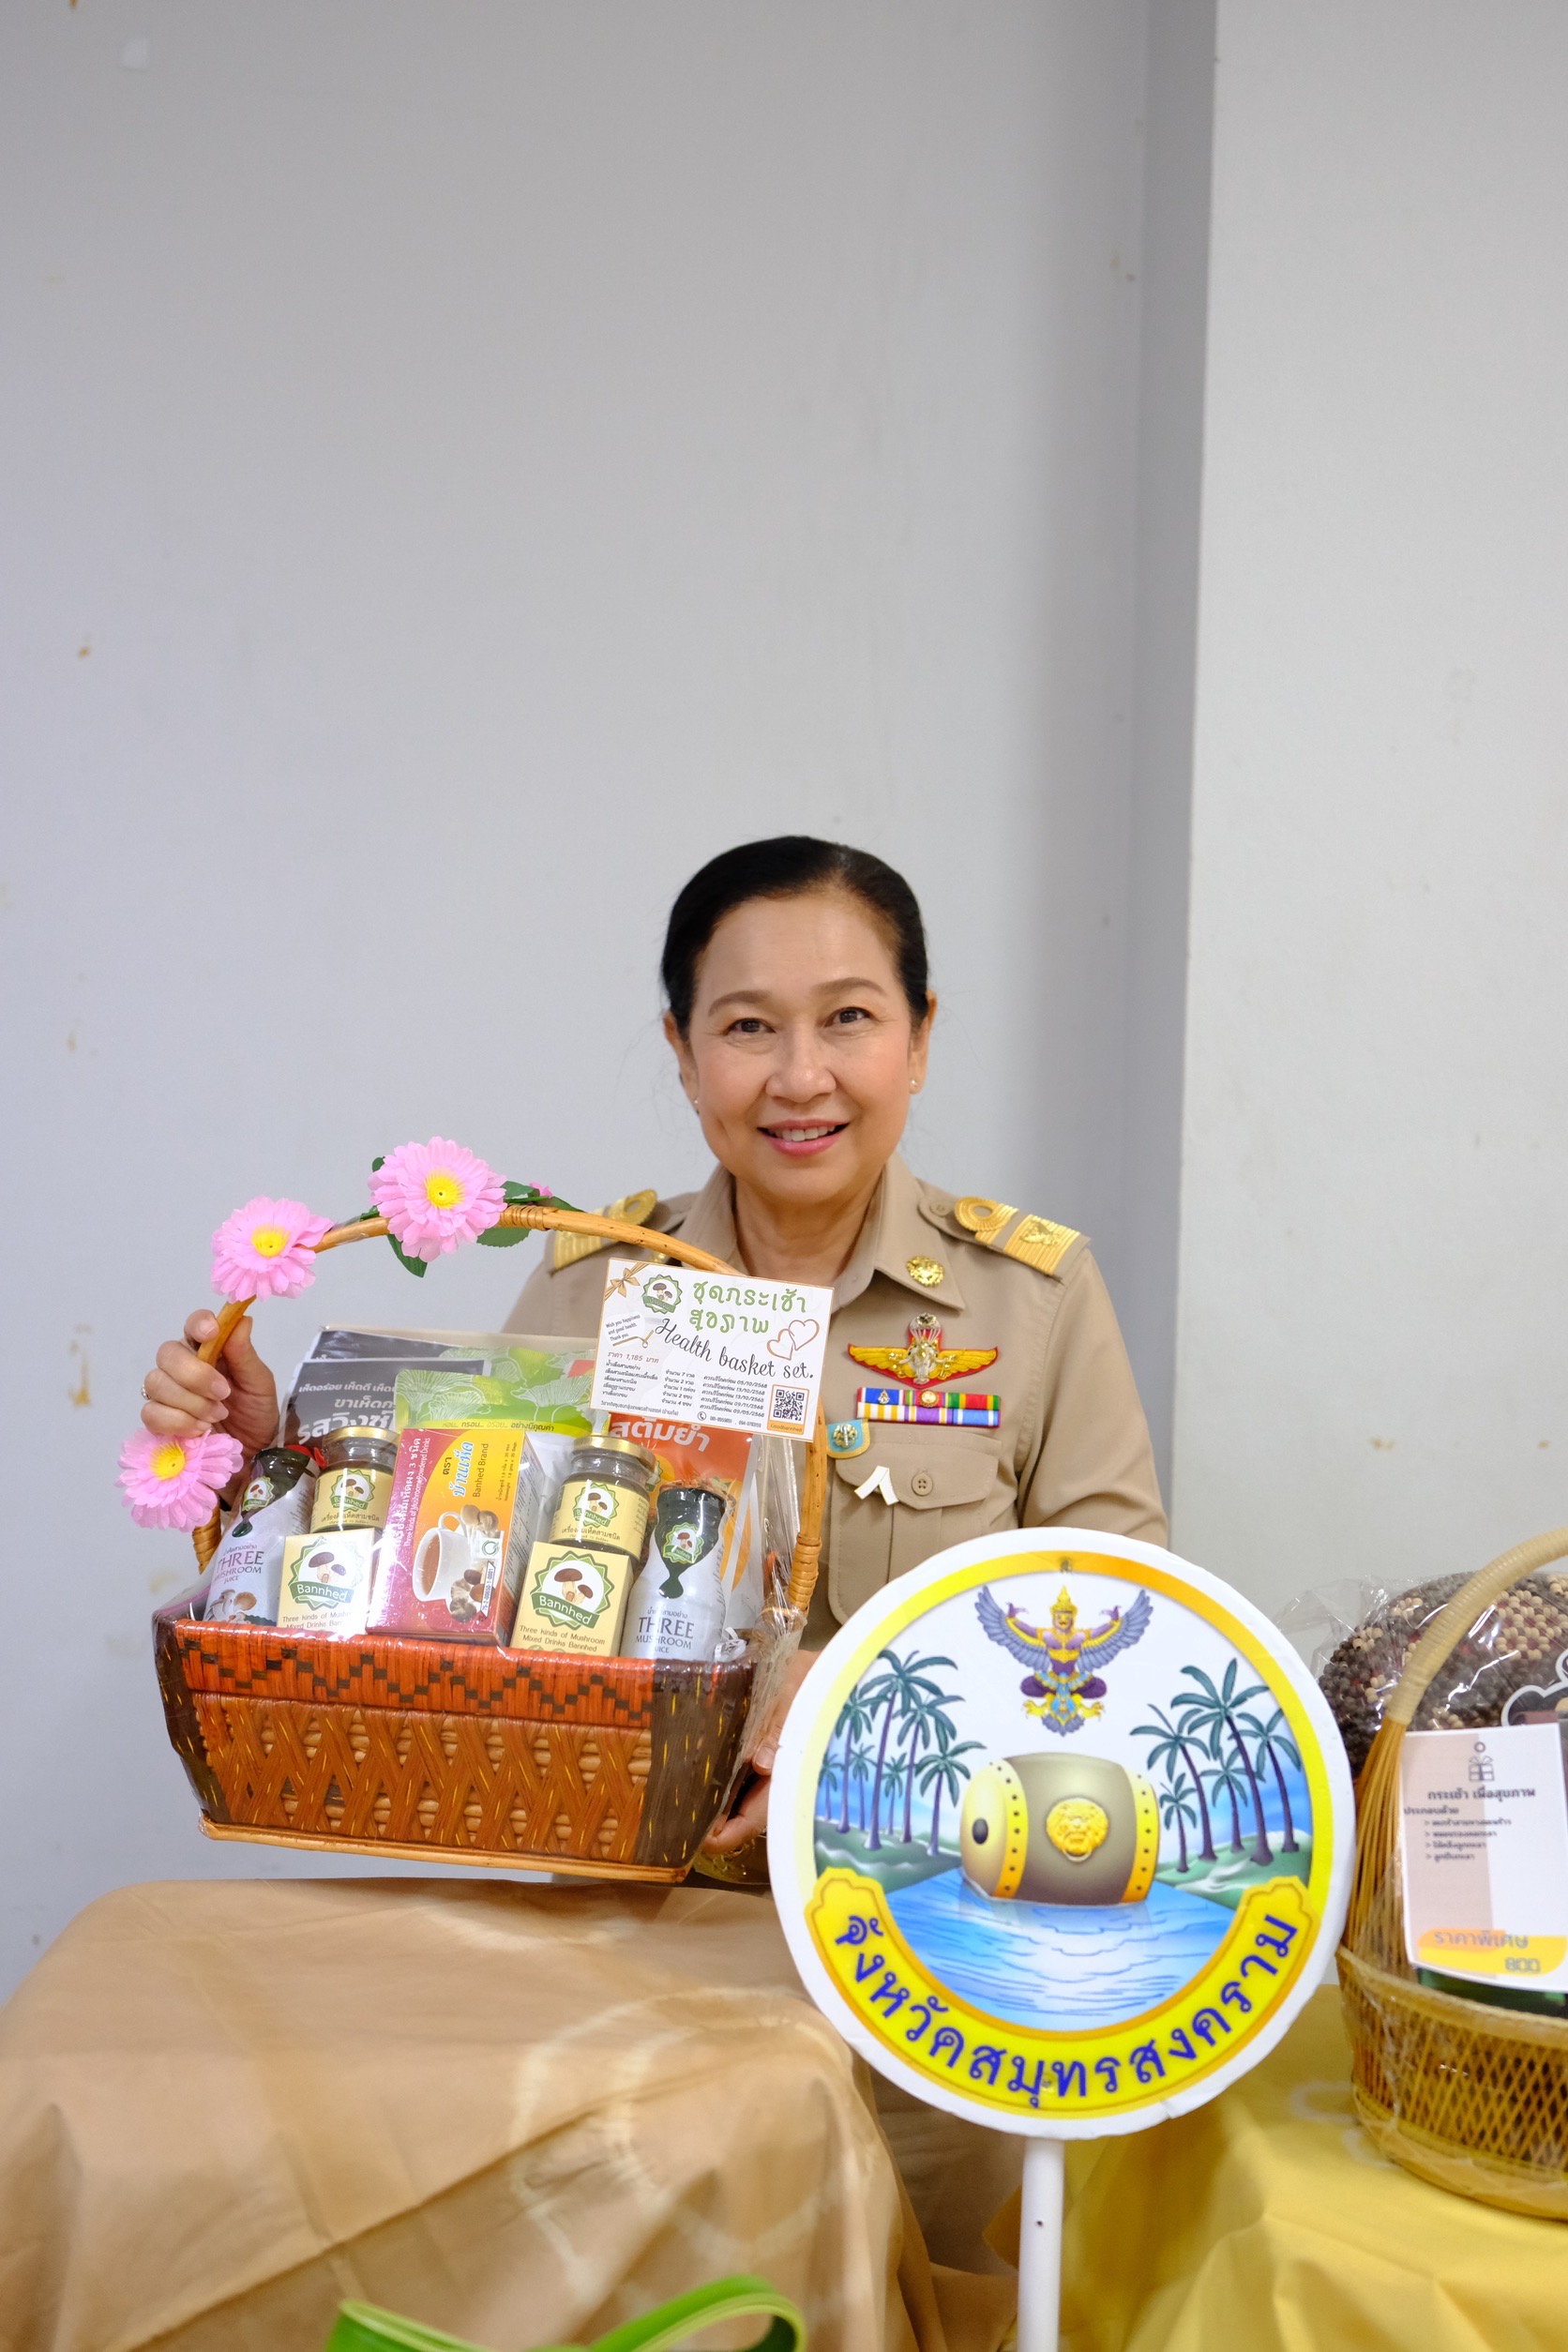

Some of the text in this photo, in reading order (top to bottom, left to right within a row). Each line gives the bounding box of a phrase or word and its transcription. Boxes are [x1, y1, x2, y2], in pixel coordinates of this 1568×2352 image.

[693, 1281, 806, 1313] ชุดกระเช้า
[622, 1314, 641, 1322] happiness
[689, 1309, 769, 1334] สุขภาพ
[626, 1353, 643, 1362] 1,185
[656, 1318, 814, 1379] Health basket set.
[298, 1382, 342, 1393] เห็ดอร่อย
[334, 1395, 395, 1409] ขาเห็ดก
[510, 1422, 554, 1432] อย่างมีคุณค่า
[409, 1438, 421, 1459] ชนิด
[421, 1438, 430, 1455] Drinks
[443, 1456, 452, 1475] ตรา
[448, 1441, 475, 1498] บ้านเห็ด
[472, 1443, 490, 1498] Banhed Brand
[577, 1510, 608, 1526] Bnnhed
[217, 1551, 264, 1574] THREE
[214, 1565, 262, 1583] MUSHROOM
[224, 1576, 239, 1584] JUICE
[296, 1584, 349, 1602] Bannhed
[539, 1595, 593, 1624] Bannhed
[520, 1624, 538, 1634] Three
[540, 1628, 558, 1637] kinds
[570, 1633, 606, 1645] Mushroom
[638, 1617, 695, 1639] THREE
[522, 1635, 597, 1652] Mixed Drinks Bannhed
[635, 1635, 692, 1650] MUSHROOM
[654, 1645, 670, 1653] UICE
[1427, 1785, 1536, 1802] กระเช้า เพื่อสุขภาพ
[1403, 1804, 1459, 1816] ประกอบด้วย
[1434, 1930, 1530, 1950] ราคาพิเศษ
[1504, 1956, 1541, 1973] 800
[834, 1913, 1299, 2109] จังหวัดสมุทรสงคราม
